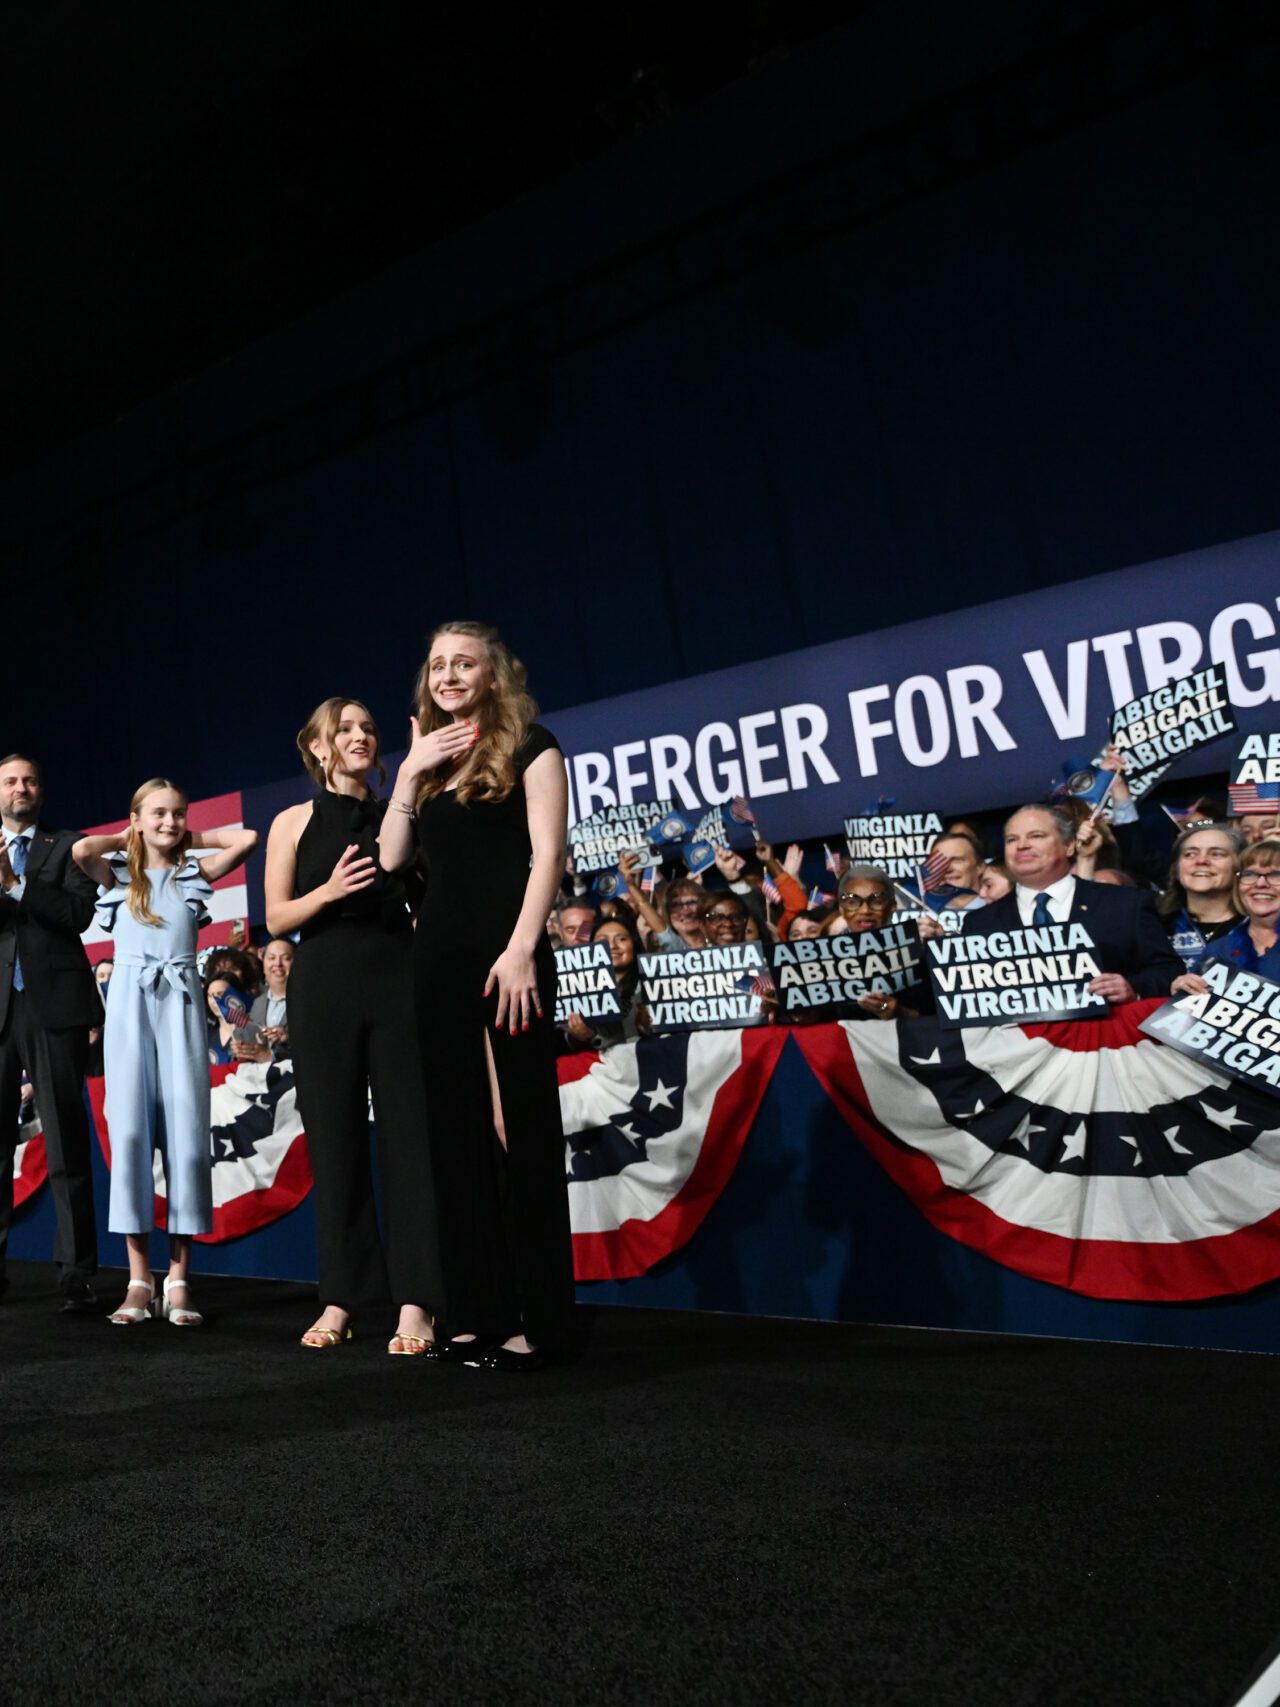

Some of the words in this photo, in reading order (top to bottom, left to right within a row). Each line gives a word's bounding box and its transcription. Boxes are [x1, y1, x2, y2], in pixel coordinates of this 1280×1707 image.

[564, 703, 840, 828] BERGER
[847, 664, 1018, 777] FOR
[1022, 596, 1280, 741] VIRG
[1112, 668, 1224, 734] ABIGAIL
[1114, 688, 1227, 750] ABIGAIL
[1121, 710, 1234, 776] ABIGAIL
[571, 819, 644, 845] ABIGAIL
[844, 812, 943, 838] VIRGINIA
[574, 833, 647, 859] ABIGAIL
[640, 944, 762, 978] VIRGINIA
[773, 924, 915, 967] ABIGAIL
[927, 923, 1095, 964] VIRGINIA
[557, 968, 616, 997] INIA
[780, 947, 919, 988] ABIGAIL
[932, 952, 1102, 992] VIRGINIA
[786, 968, 923, 1010] ABIGAIL
[938, 982, 1106, 1020] VIRGINIA
[647, 995, 762, 1025] VIRGINIA
